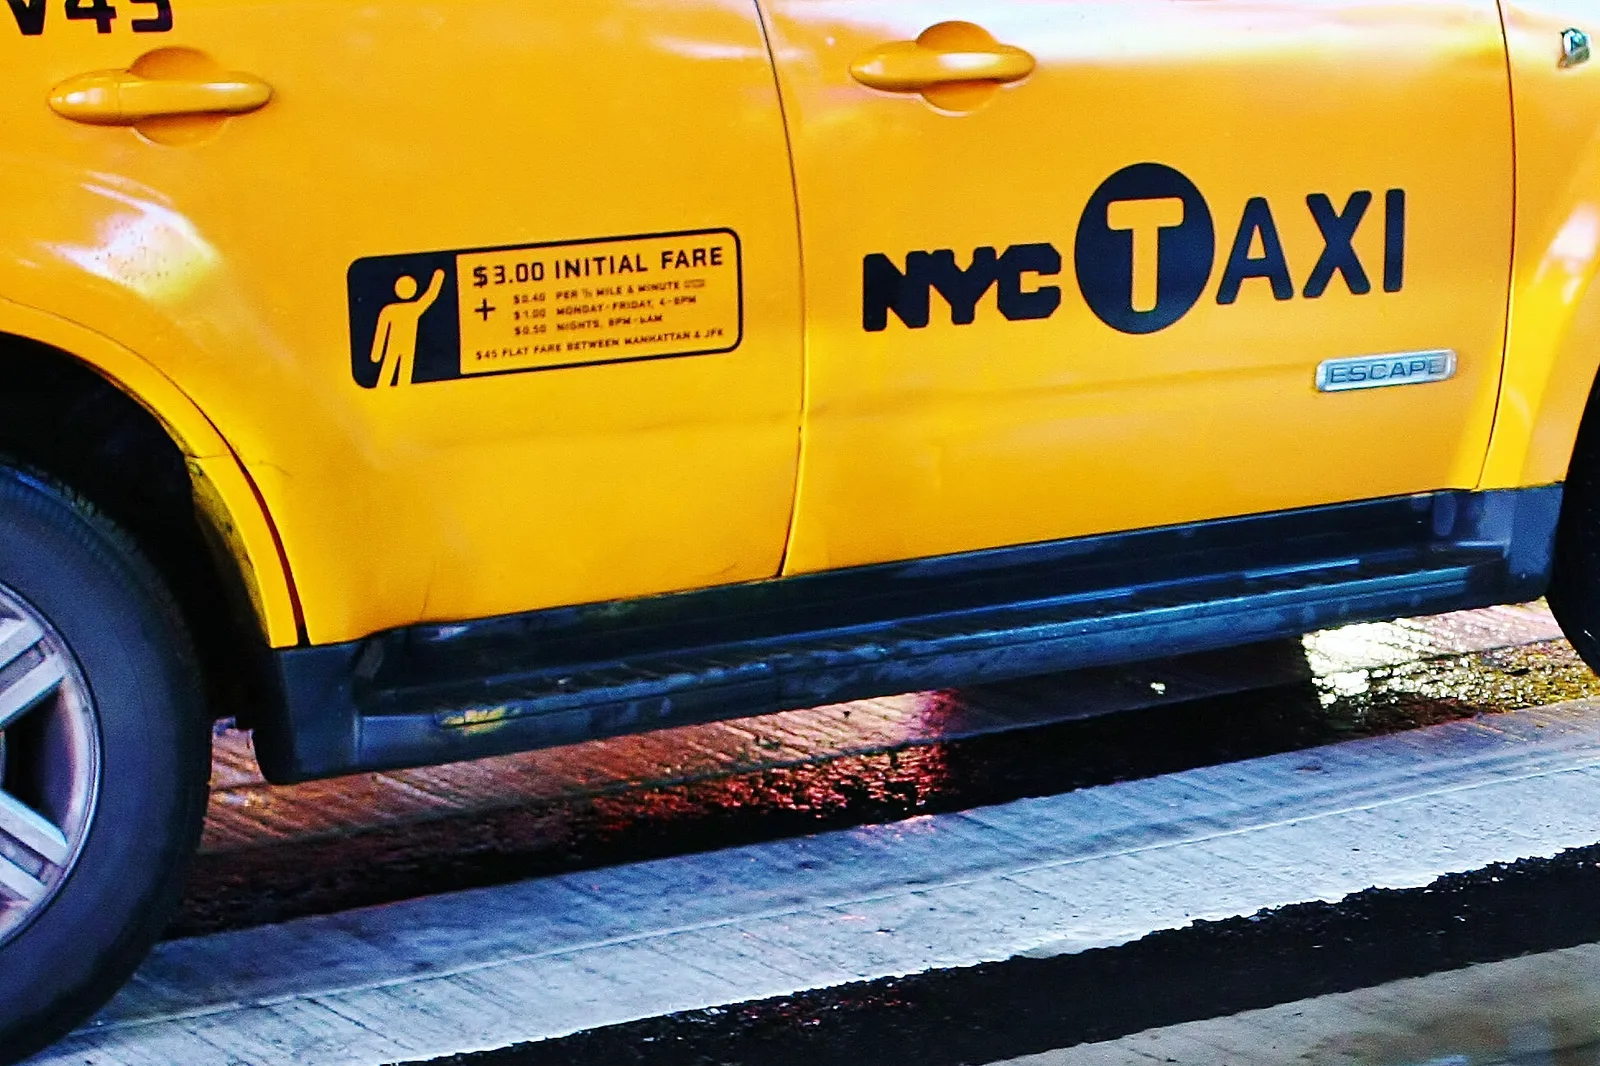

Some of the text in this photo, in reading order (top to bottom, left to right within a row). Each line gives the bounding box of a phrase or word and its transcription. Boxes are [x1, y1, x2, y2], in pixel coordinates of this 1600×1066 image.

[473, 247, 723, 288] $3.00 INITIAL FARE
[862, 186, 1406, 332] NYC TAXI
[556, 289, 578, 299] PER
[596, 285, 622, 296] MILE
[638, 280, 679, 292] MINUTE
[476, 350, 497, 361] $45
[502, 347, 528, 357] FLAT
[534, 344, 561, 353] FARE
[567, 339, 619, 351] BETWEEN
[625, 332, 690, 345] MANHATTAN
[705, 328, 723, 338] JFK
[1331, 357, 1446, 383] ESCAPE
